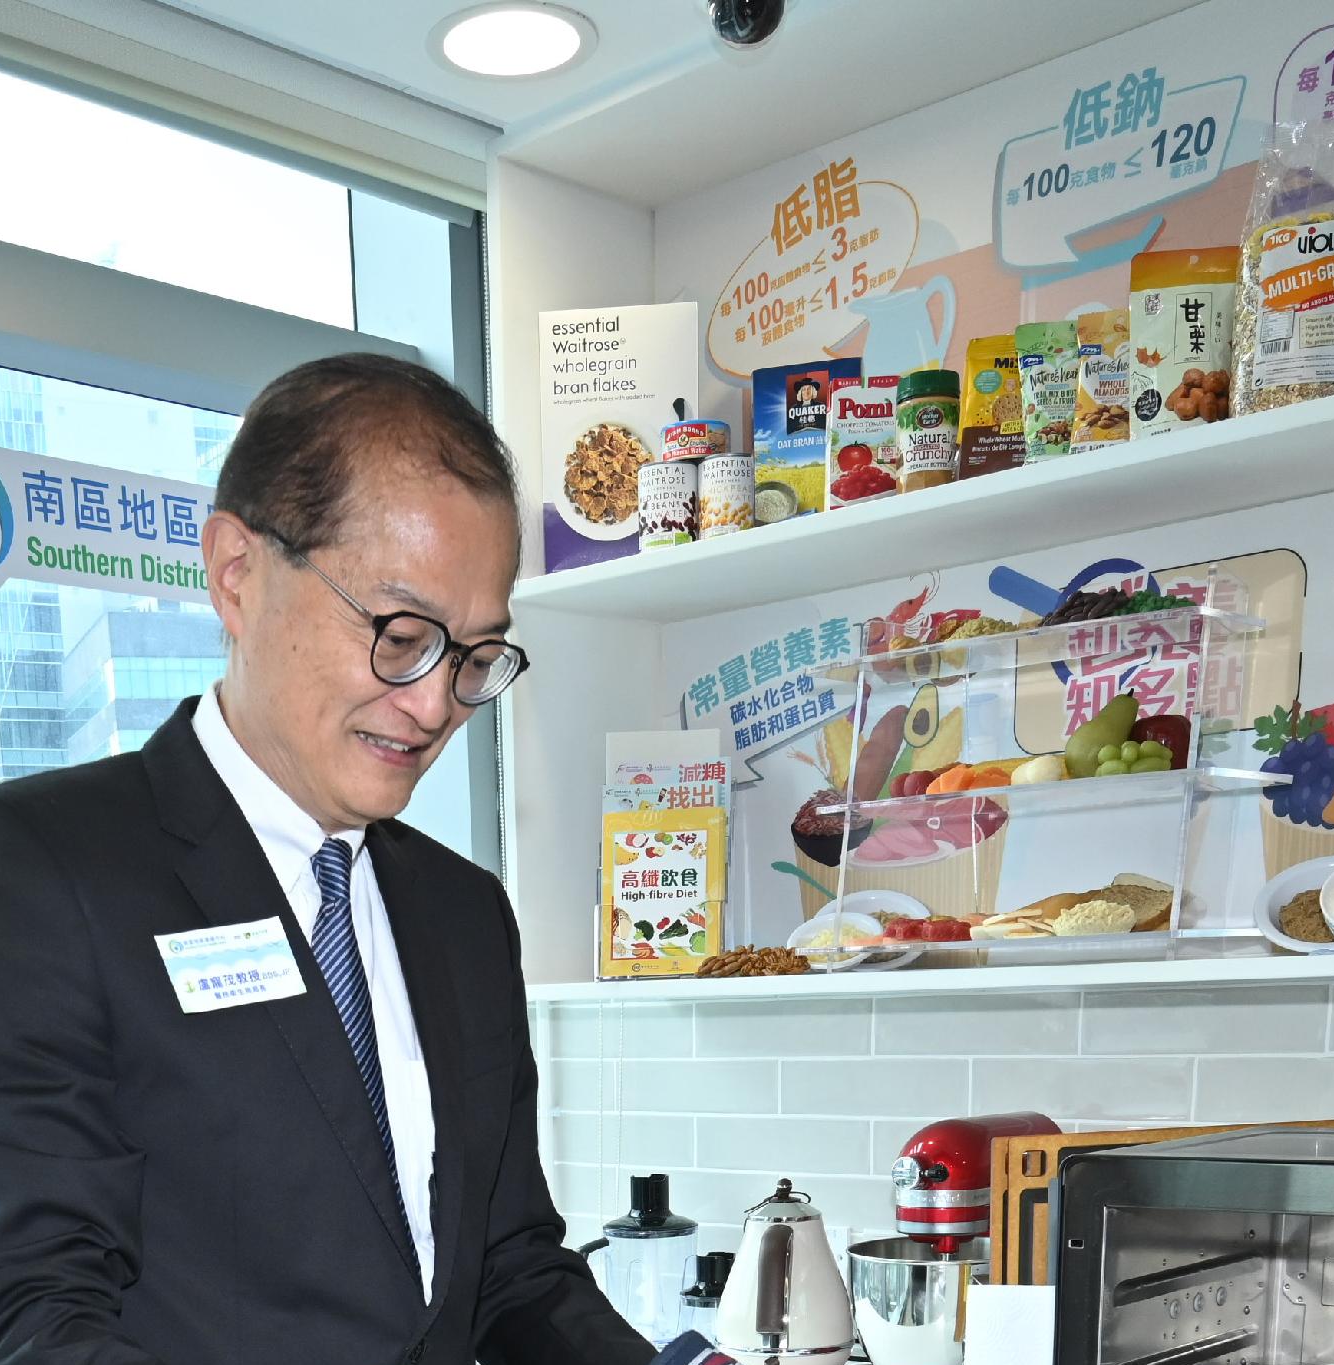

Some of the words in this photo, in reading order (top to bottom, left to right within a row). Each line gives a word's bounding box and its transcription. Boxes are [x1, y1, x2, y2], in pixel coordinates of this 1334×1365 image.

[1063, 66, 1165, 151] 低鈉
[770, 156, 861, 257] 低脂
[1269, 232, 1291, 244] 1KG
[552, 315, 620, 336] essential
[1179, 297, 1206, 355] 甘栗
[553, 355, 637, 376] wholegrain
[553, 380, 589, 395] bran
[593, 377, 637, 393] flakes
[1093, 387, 1129, 398] ALMONDS
[1098, 379, 1127, 389] WHOLE
[788, 404, 827, 420] QUAKER
[909, 430, 951, 446] Natural
[905, 447, 953, 463] Crunchy
[22, 469, 216, 548] 南區地區
[27, 535, 134, 581] Southern
[687, 617, 851, 719] 常量營養素
[729, 673, 815, 726] 碳水化合物
[734, 688, 838, 751] 脂肪和蛋白質
[678, 761, 727, 785] 減糖
[667, 783, 716, 810] 找出
[621, 868, 699, 889] 高纖飲食
[621, 889, 674, 903] High-fibre
[676, 889, 698, 899] Diet
